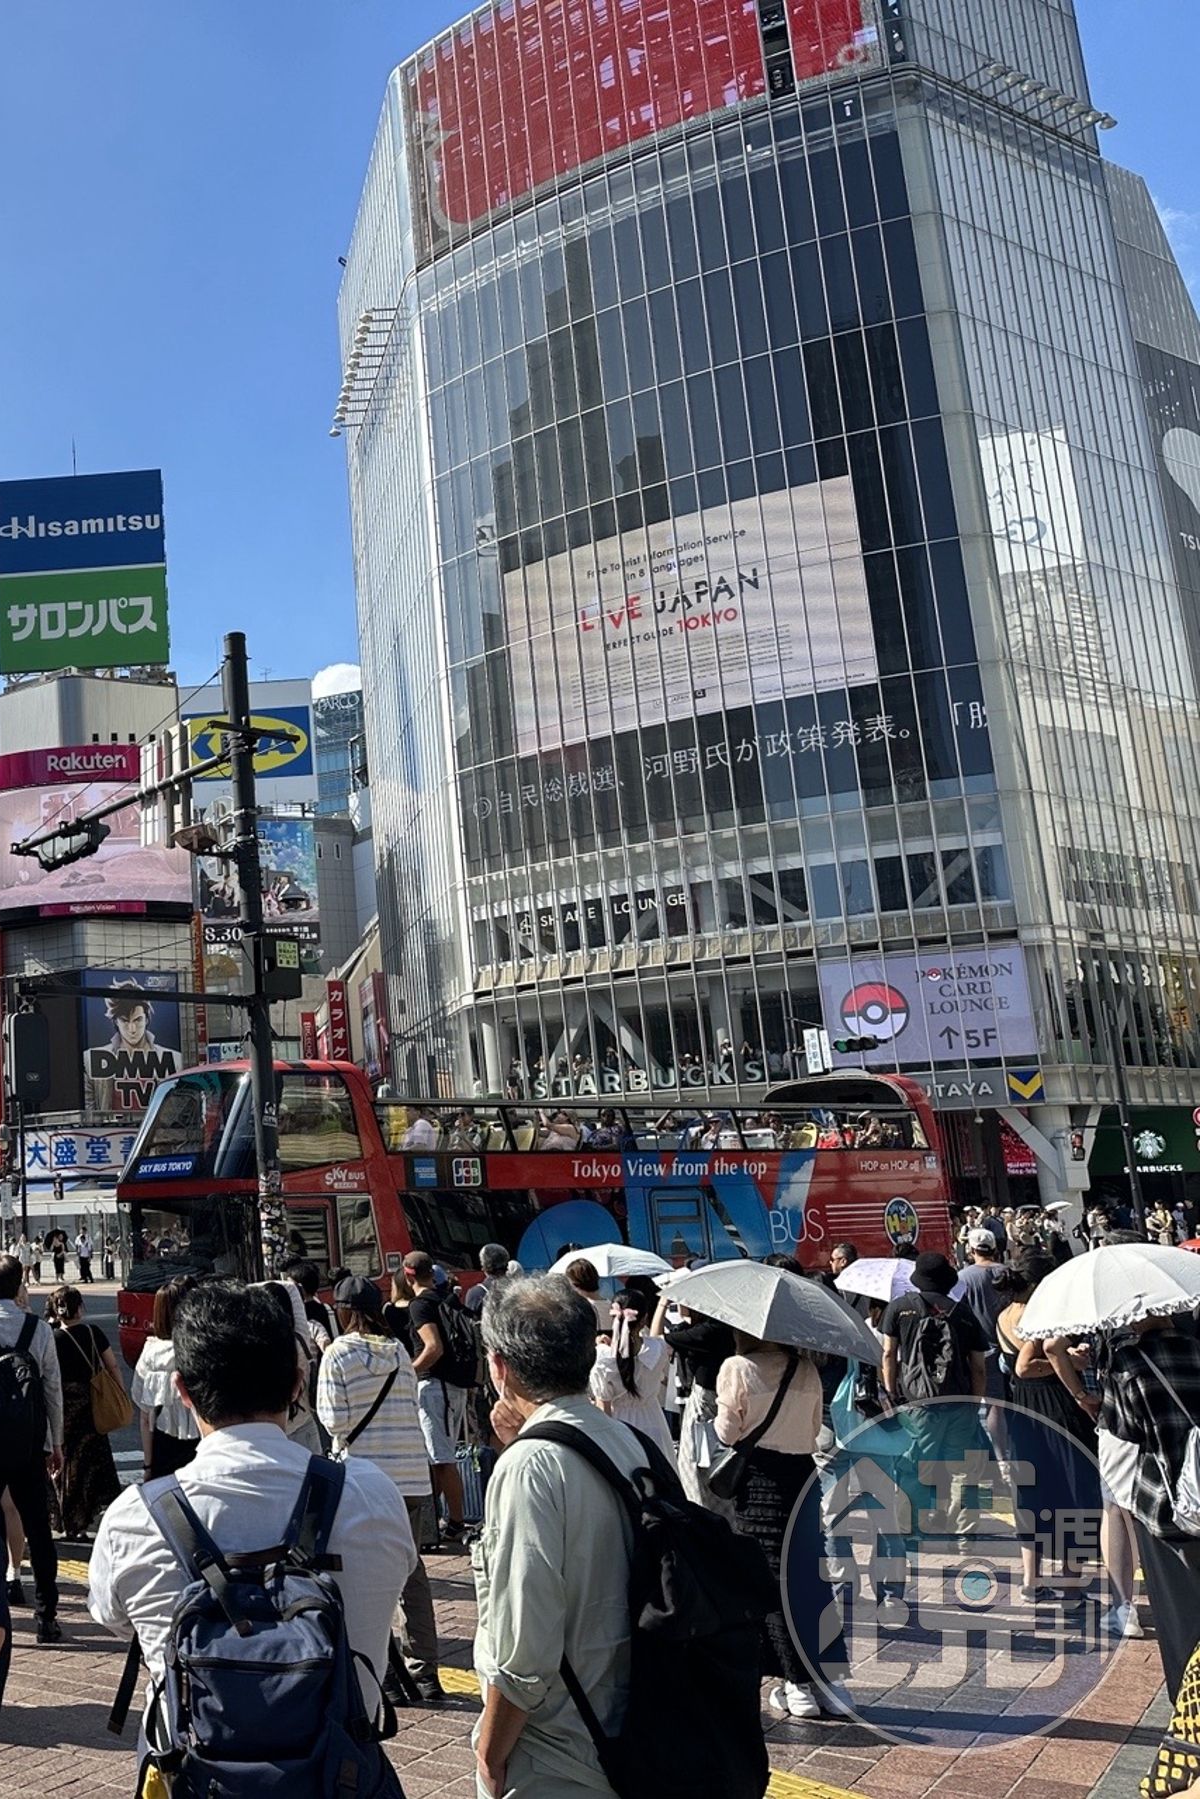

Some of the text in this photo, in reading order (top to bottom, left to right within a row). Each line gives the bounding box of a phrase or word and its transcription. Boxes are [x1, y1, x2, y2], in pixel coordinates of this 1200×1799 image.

[587, 567, 608, 579] Fre
[610, 558, 641, 572] Torist
[581, 567, 760, 632] LVE JAPAN
[7, 596, 157, 641] サロンパス
[676, 607, 738, 633] TOKYO
[316, 692, 360, 711] PARCO
[48, 752, 127, 773] Rakuten
[205, 926, 242, 942] 8.30
[938, 980, 992, 998] CARD
[928, 996, 1010, 1016] LOUNGE
[330, 989, 348, 1059] カラオケ
[966, 1027, 998, 1049] 5F
[90, 1049, 177, 1079] DMM
[534, 1060, 763, 1099] STARBUCKS
[115, 1080, 156, 1109] TV
[139, 1161, 193, 1174] SKY BUS TOKYO
[456, 1167, 480, 1177] JCB
[572, 1158, 767, 1180] Tokyo View from the top
[860, 1161, 878, 1171] HOP
[890, 1160, 908, 1171] HOP
[1123, 1164, 1183, 1174] SARBUCKS
[325, 1167, 348, 1186] SKY
[349, 1171, 365, 1180] BUS
[769, 1207, 825, 1244] BUS
